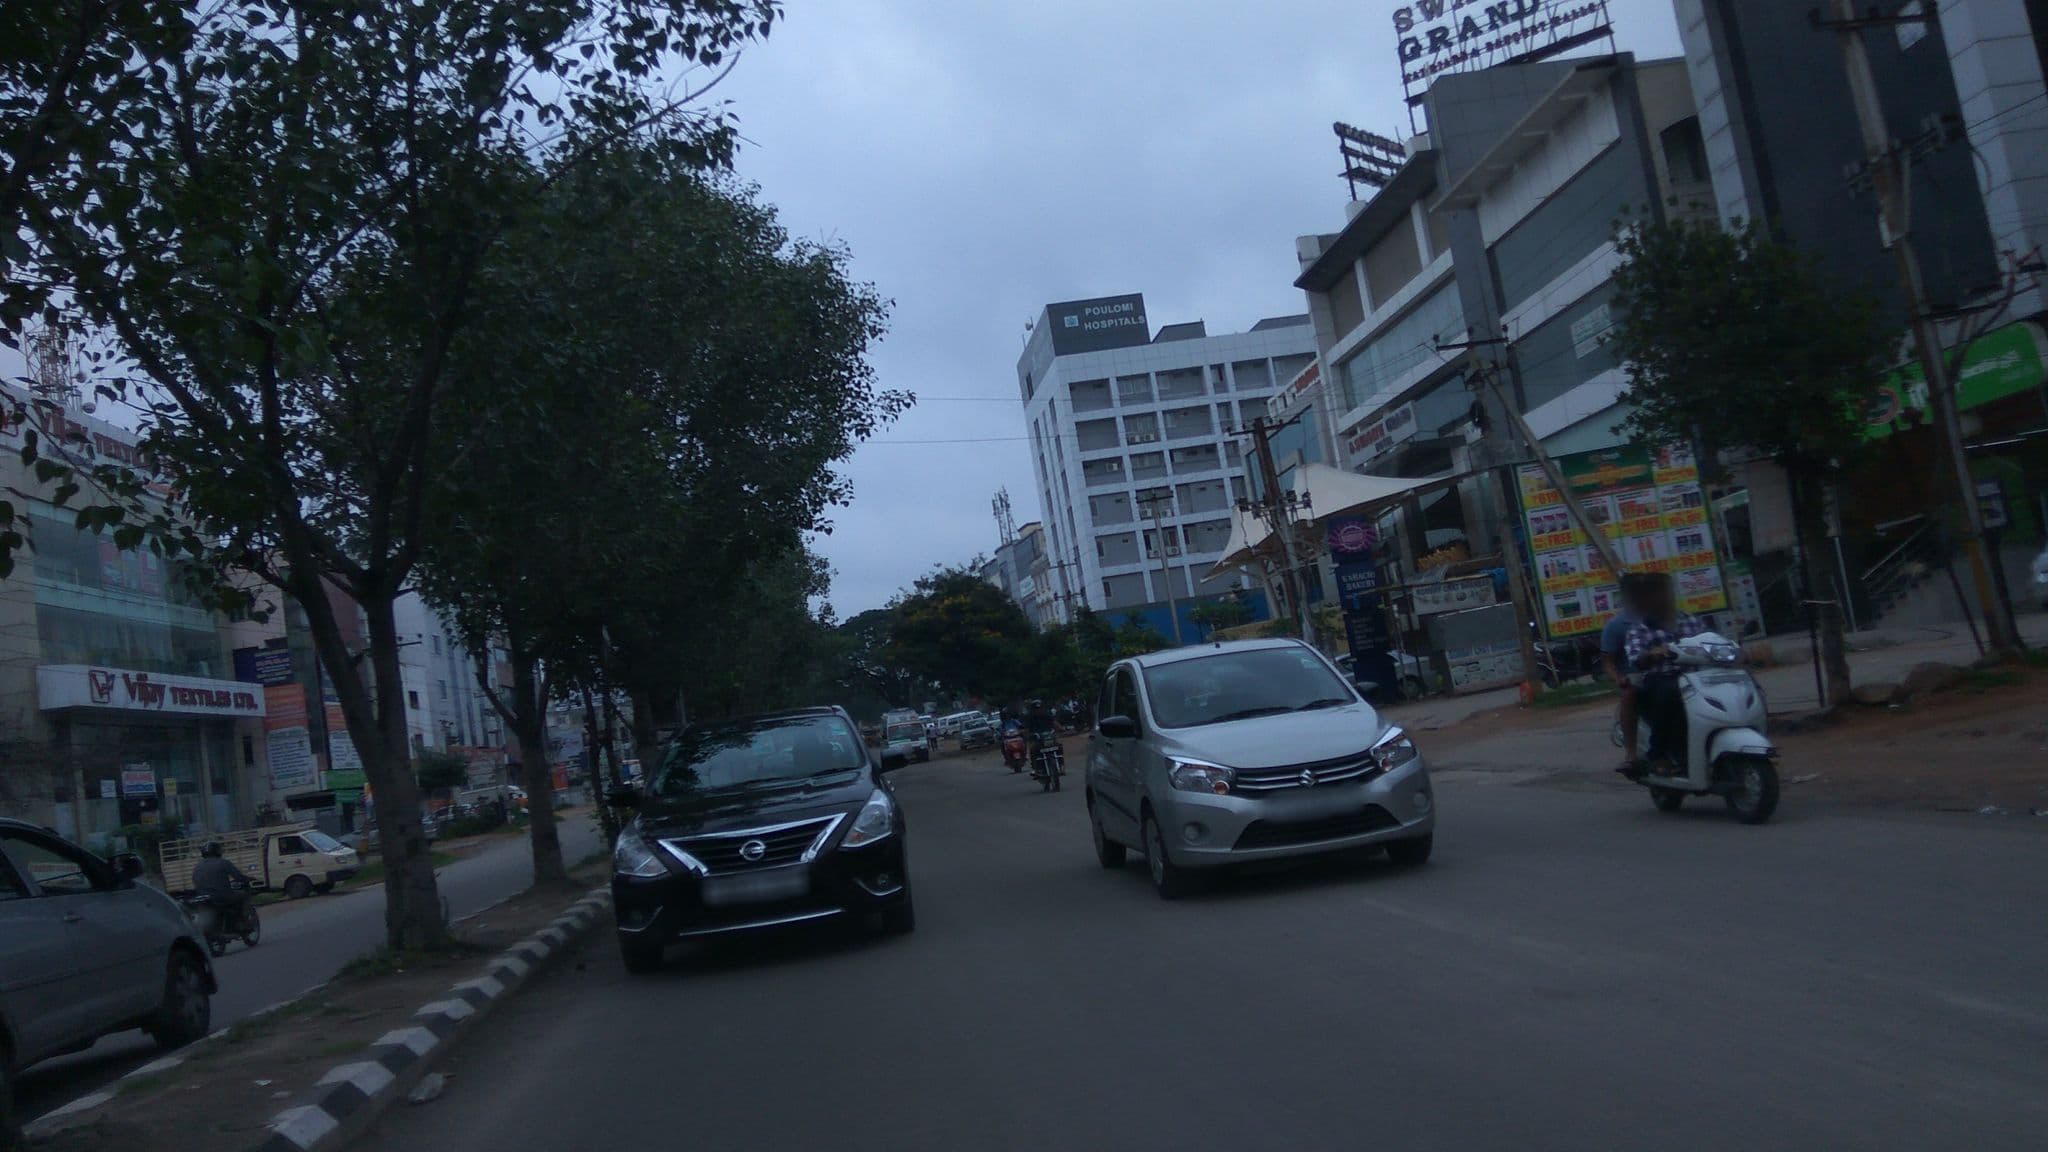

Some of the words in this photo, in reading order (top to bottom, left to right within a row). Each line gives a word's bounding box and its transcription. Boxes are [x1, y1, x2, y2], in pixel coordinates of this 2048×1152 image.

[1398, 0, 1542, 61] GRAND
[1085, 303, 1133, 315] POULOMI
[1084, 316, 1145, 330] HOSPITALS
[123, 672, 166, 709] Vijay
[170, 686, 232, 707] TEXTILES
[233, 691, 258, 710] LTD.
